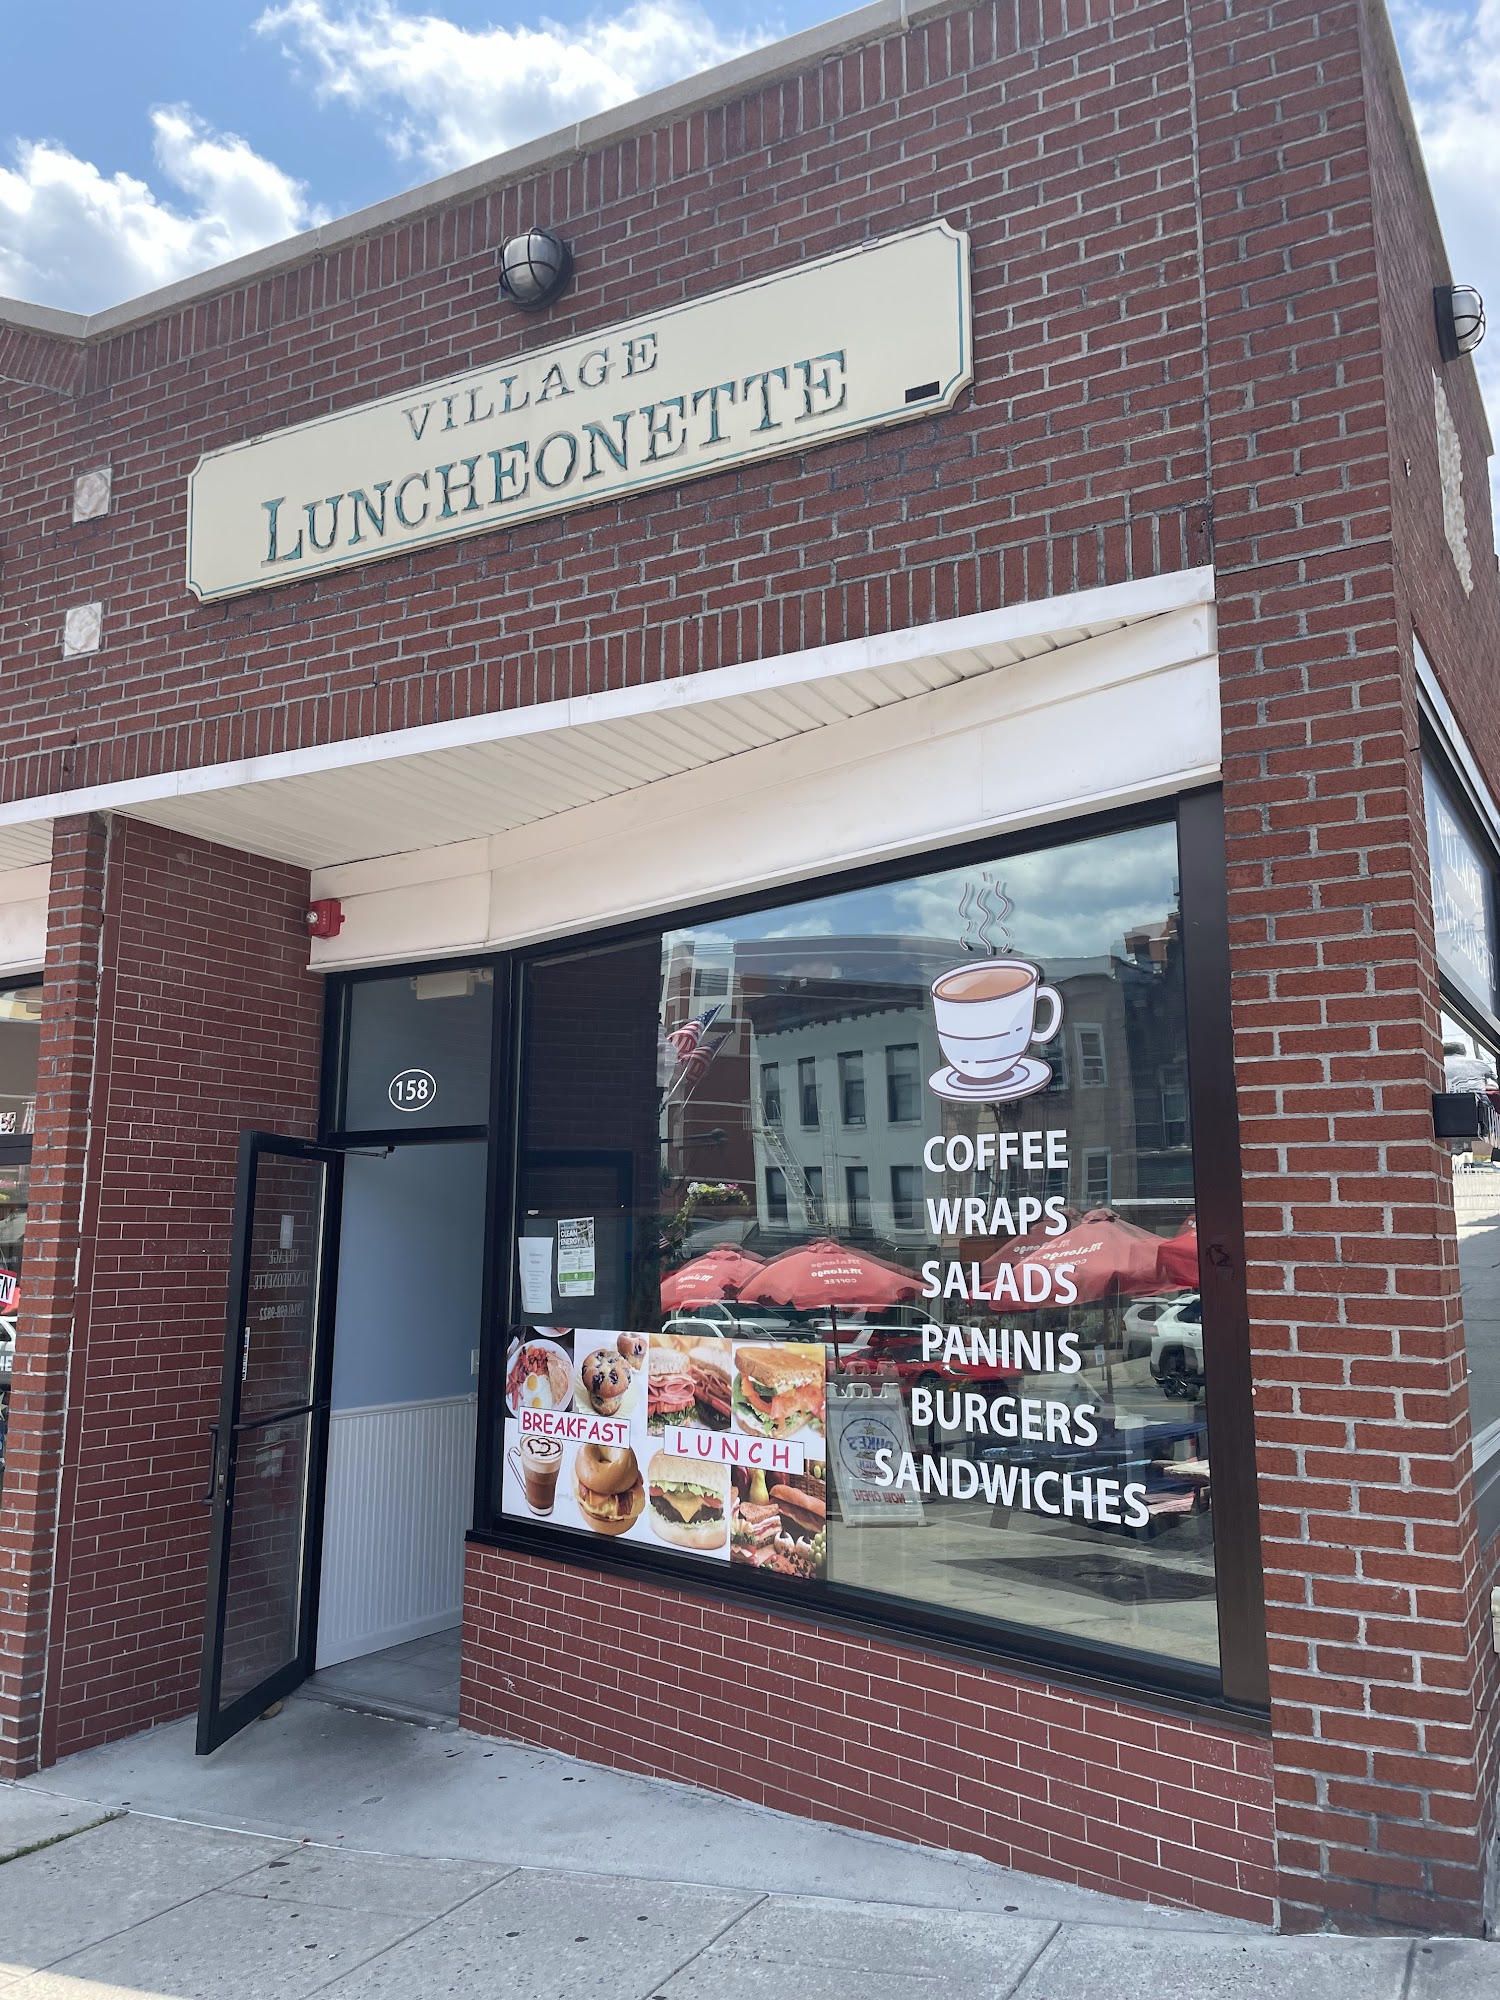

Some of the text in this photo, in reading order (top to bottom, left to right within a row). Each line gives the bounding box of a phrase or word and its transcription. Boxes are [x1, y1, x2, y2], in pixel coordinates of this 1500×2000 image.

[401, 331, 659, 441] VILLAGE
[259, 348, 849, 567] LUNCHEONETTE
[396, 1078, 428, 1101] 158
[923, 1129, 1069, 1173] COFFEE
[926, 1195, 1068, 1236] WRAPS
[921, 1261, 1079, 1305] SALADS
[921, 1325, 1082, 1374] PANINIS
[522, 1411, 628, 1444] BREAKFAST
[911, 1388, 1098, 1447] BURGERS
[676, 1431, 790, 1469] LUNCH
[873, 1448, 1150, 1529] SANDWICHES
